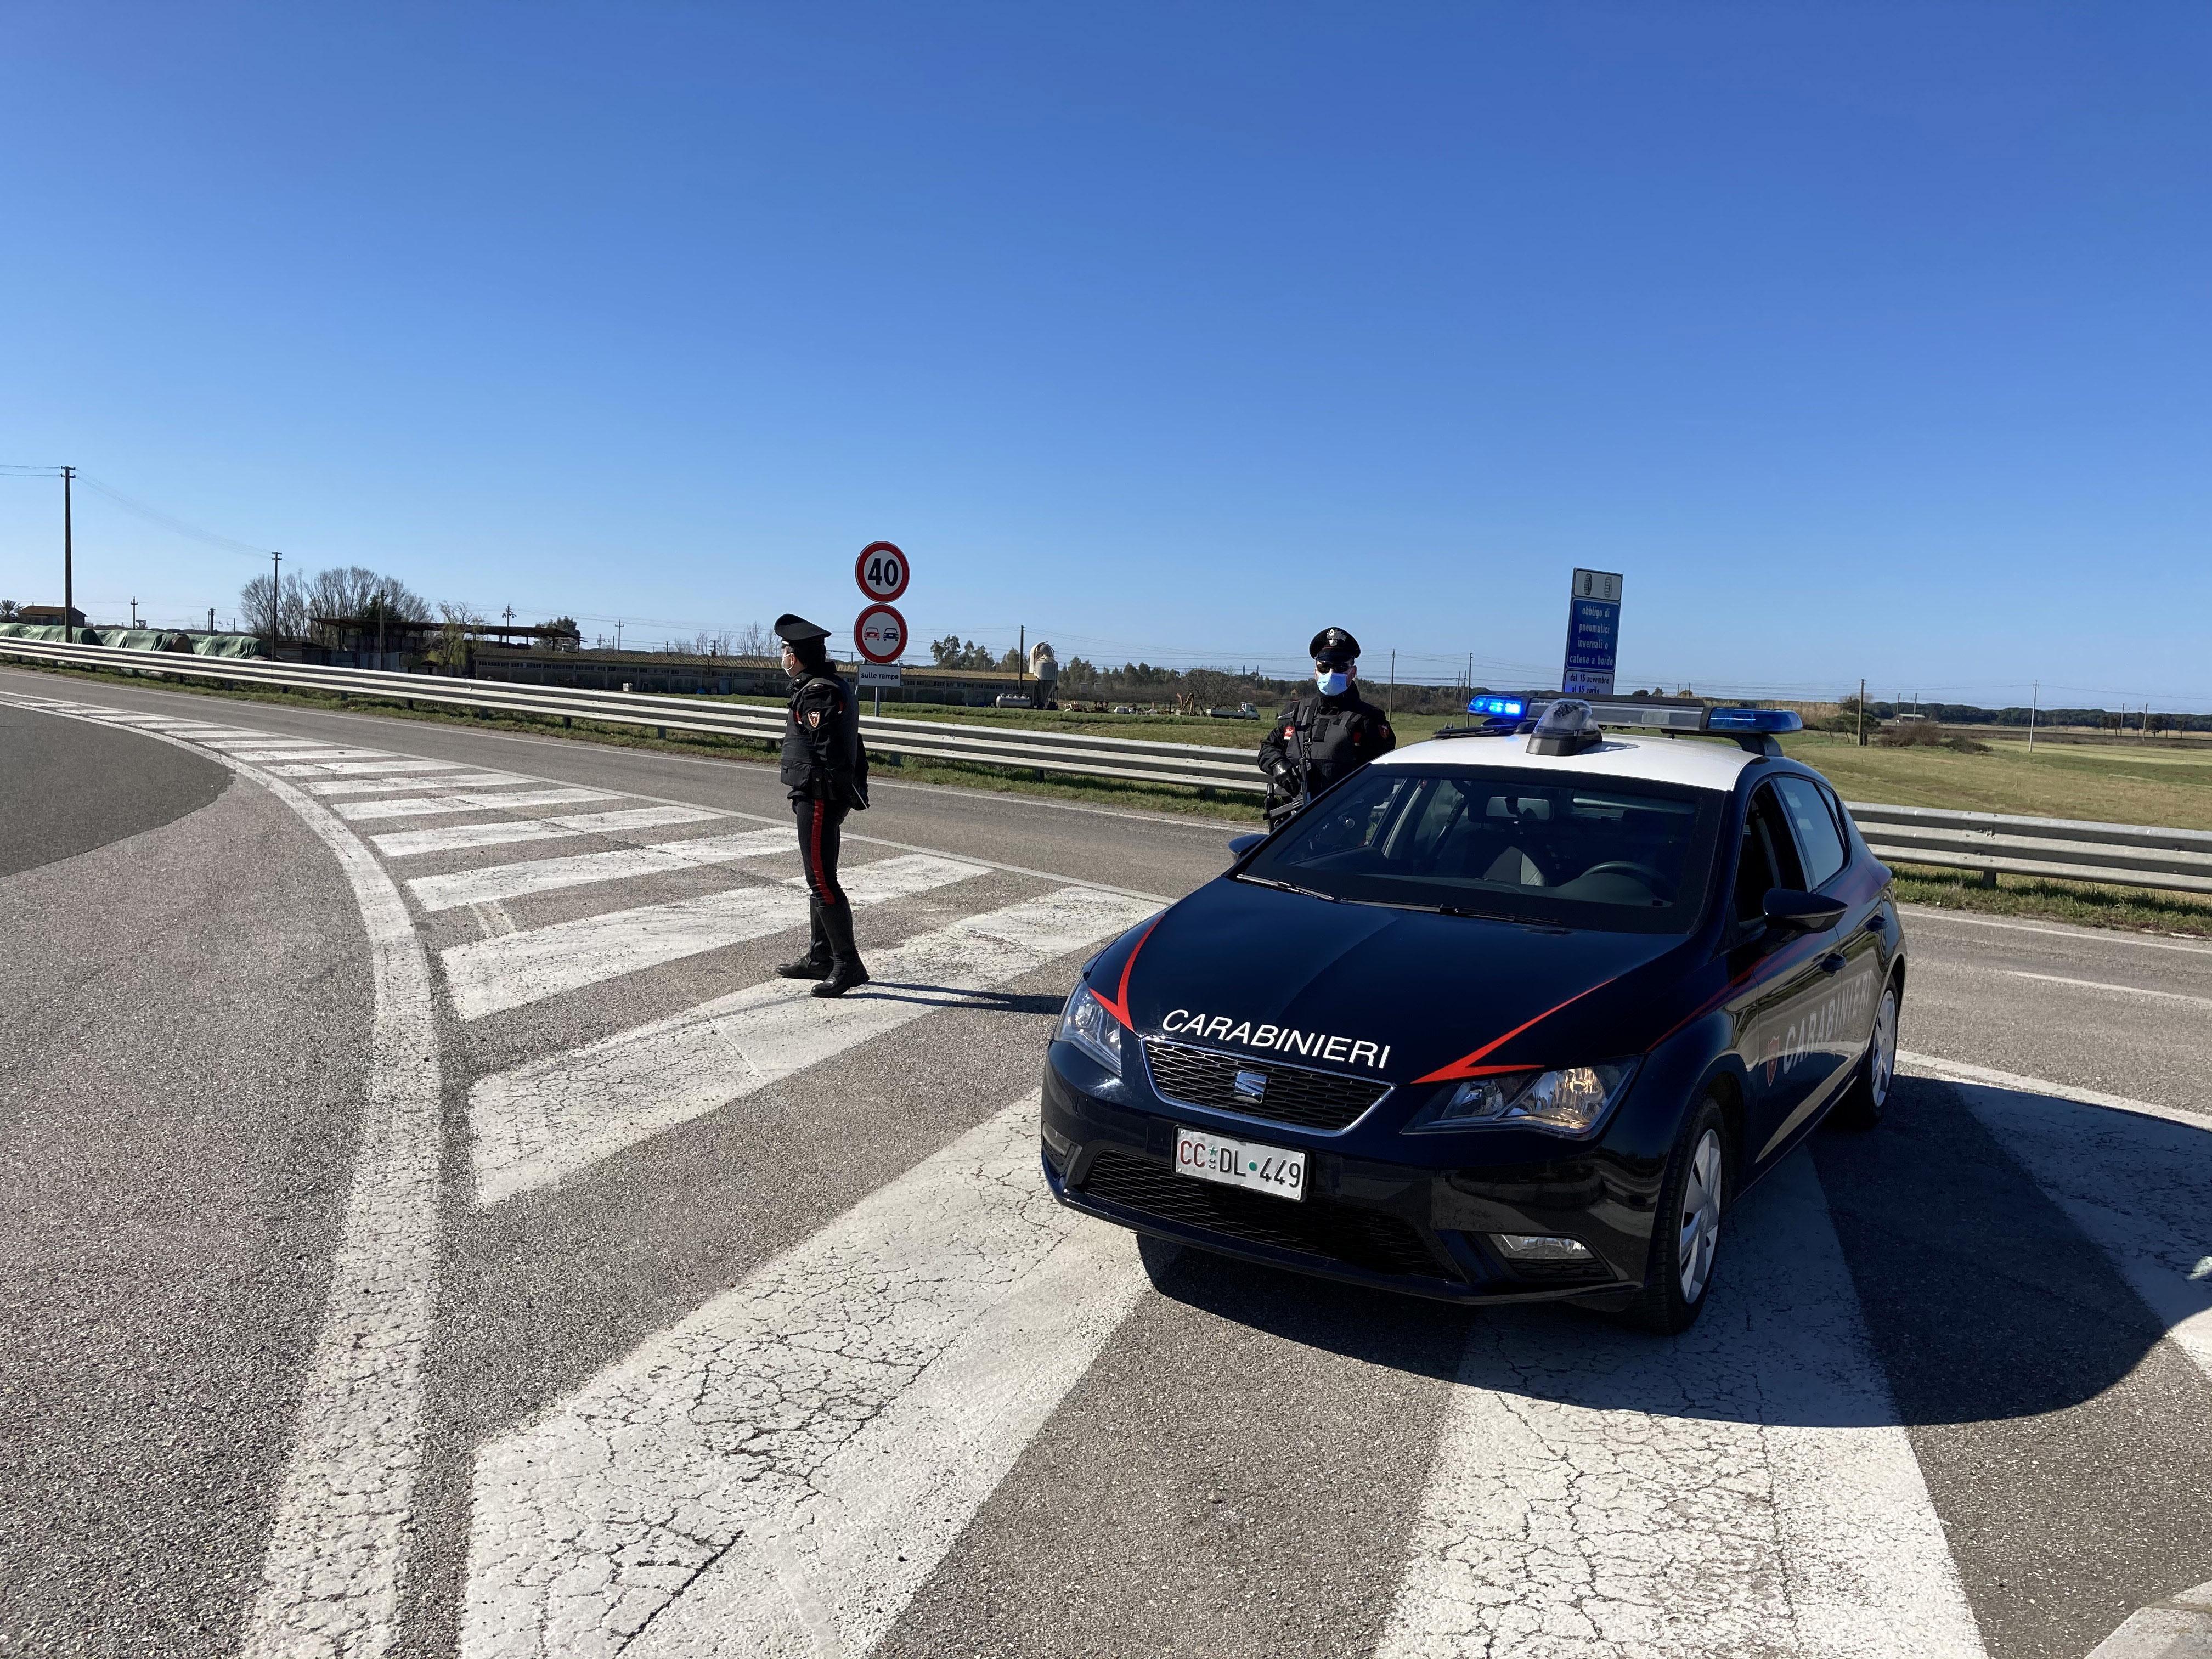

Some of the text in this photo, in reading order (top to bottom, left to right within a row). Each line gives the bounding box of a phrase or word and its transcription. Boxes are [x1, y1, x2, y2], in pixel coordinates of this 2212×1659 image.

[867, 558, 899, 587] 40
[1582, 605, 1610, 619] obbligo di
[1579, 623, 1610, 634] pneumatici
[1578, 637, 1603, 649] invernali
[1570, 654, 1589, 664] catene
[1598, 655, 1613, 666] bordo
[1580, 674, 1585, 682] 15
[1587, 676, 1609, 684] novembre
[1579, 685, 1585, 693] 15
[1783, 969, 1872, 1075] CARABINIERI
[1162, 1009, 1391, 1069] CARABINIERI
[1180, 1140, 1301, 1188] CC DL 449
